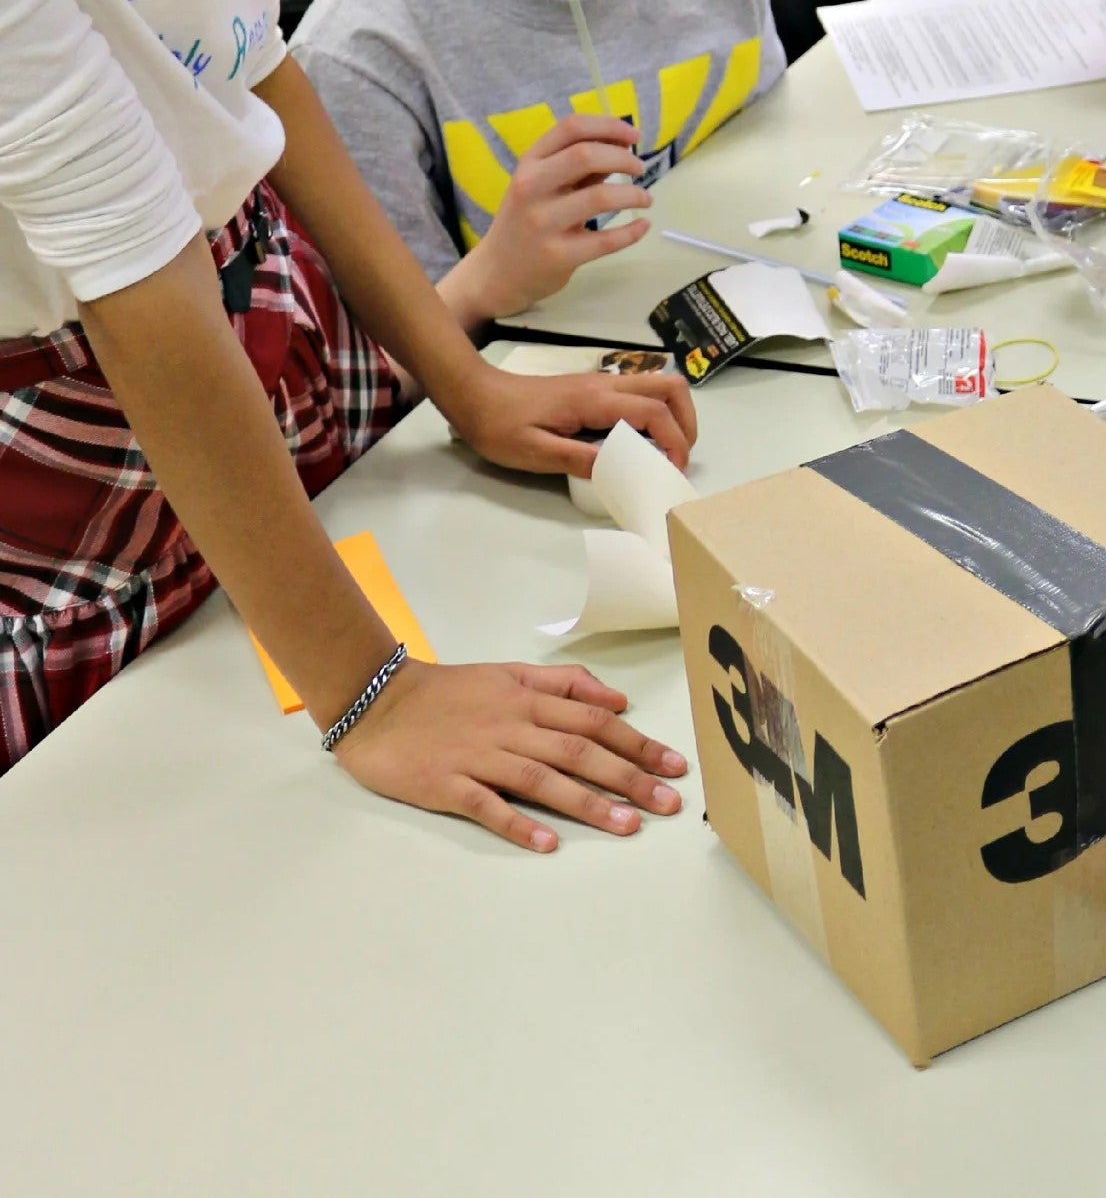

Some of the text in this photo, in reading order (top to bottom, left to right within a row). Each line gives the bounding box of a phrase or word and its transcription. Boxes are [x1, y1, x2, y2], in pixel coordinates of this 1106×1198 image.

[897, 193, 947, 212] Scotch
[841, 243, 889, 267] Scotch
[708, 624, 867, 901] 3M
